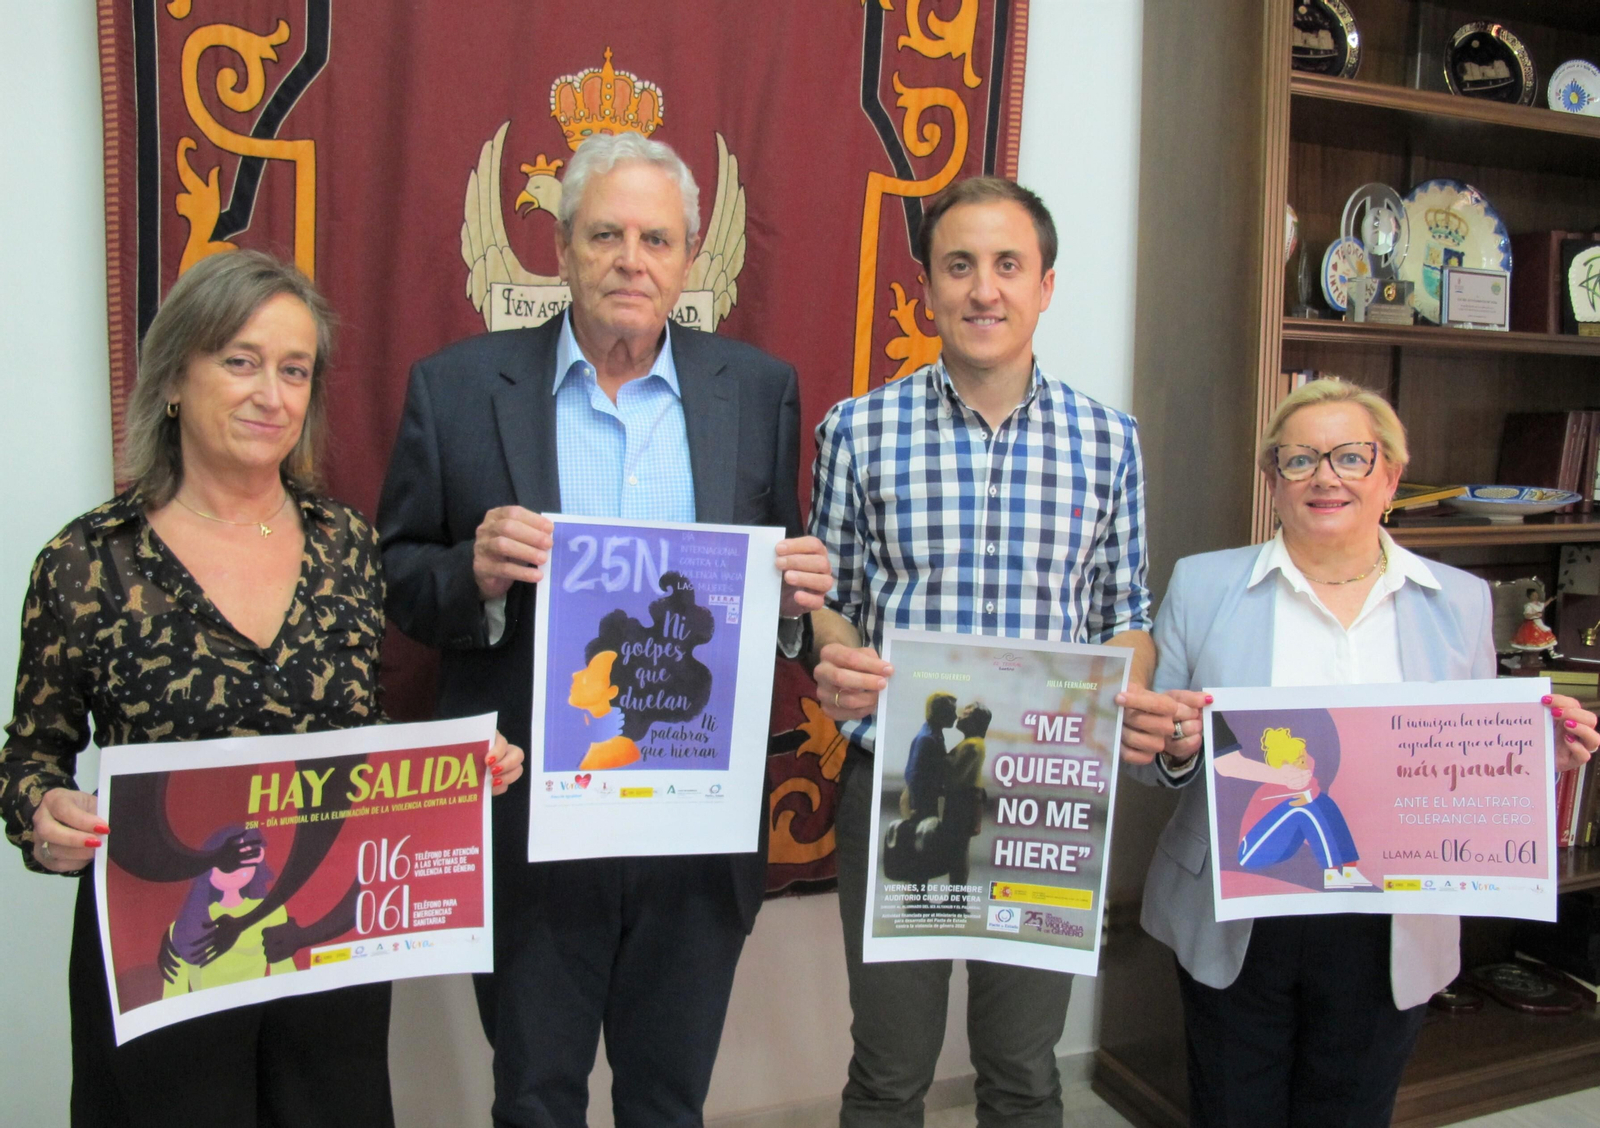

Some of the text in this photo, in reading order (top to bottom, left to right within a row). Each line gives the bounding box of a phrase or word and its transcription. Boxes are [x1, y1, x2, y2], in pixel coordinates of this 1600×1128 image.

[680, 544, 740, 557] INTERNACIONAL
[562, 534, 670, 597] 25N
[679, 557, 727, 568] CONTRA LA
[679, 569, 743, 581] VIOLENCIA HACIA
[677, 581, 735, 593] LAS MUJERES
[663, 610, 691, 641] Ni
[621, 637, 686, 666] golpes
[635, 667, 671, 689] que
[912, 671, 971, 682] ANTONIO GUERRERO
[1046, 679, 1098, 691] JULIA FERNÁNDEZ
[619, 685, 692, 712] duelan
[701, 712, 719, 733] Ni
[1460, 712, 1474, 727] la
[1476, 711, 1534, 727] violencia
[650, 725, 711, 744] palabras
[640, 743, 719, 762] que hieran
[1397, 733, 1535, 757] ayuda a que se haga
[994, 754, 1105, 794] QUIERE,
[1396, 760, 1438, 778] más
[248, 752, 479, 815] HAY SALIDA
[1394, 796, 1430, 808] ANTE
[1433, 796, 1449, 808] EL
[245, 820, 259, 830] 25N
[266, 816, 278, 828] DÍA
[279, 814, 309, 826] MUNDIAL
[310, 812, 320, 822] DE
[320, 811, 330, 821] LA
[331, 805, 370, 820] ELIMINACIÓN
[370, 805, 380, 815] DE
[380, 805, 390, 814] LA
[391, 801, 422, 812] VIOLENCIA
[423, 797, 448, 808] CONTRA
[448, 796, 457, 805] LA
[457, 793, 478, 804] MUJER
[997, 797, 1091, 830] NO ME
[1398, 813, 1536, 826] TOLERANCIA CERO.
[357, 834, 411, 885] 016
[414, 846, 480, 861] TELÉFONO DE ATENCIÓN
[1382, 850, 1422, 860] LLAMA
[1425, 850, 1439, 860] AL
[1441, 838, 1472, 863] 016
[1487, 853, 1503, 864] AL
[1505, 839, 1537, 865] 061
[414, 856, 467, 870] A LAS VÍCTIMAS DE
[414, 863, 476, 877] VIOLENCIA DE GÉNERO
[883, 883, 920, 893] VIERNES,
[920, 884, 926, 892] 2
[927, 884, 938, 892] DE
[940, 884, 983, 894] DICIEMBRE
[413, 898, 458, 911] TELÉFONO PARA
[884, 893, 982, 903] AUDITORIO CIUDAD DE VERA
[356, 884, 410, 935] 061
[413, 907, 453, 919] EMERGENCIAS
[413, 916, 447, 927] SANITARIAS
[1045, 921, 1084, 932] VIOLENCIA
